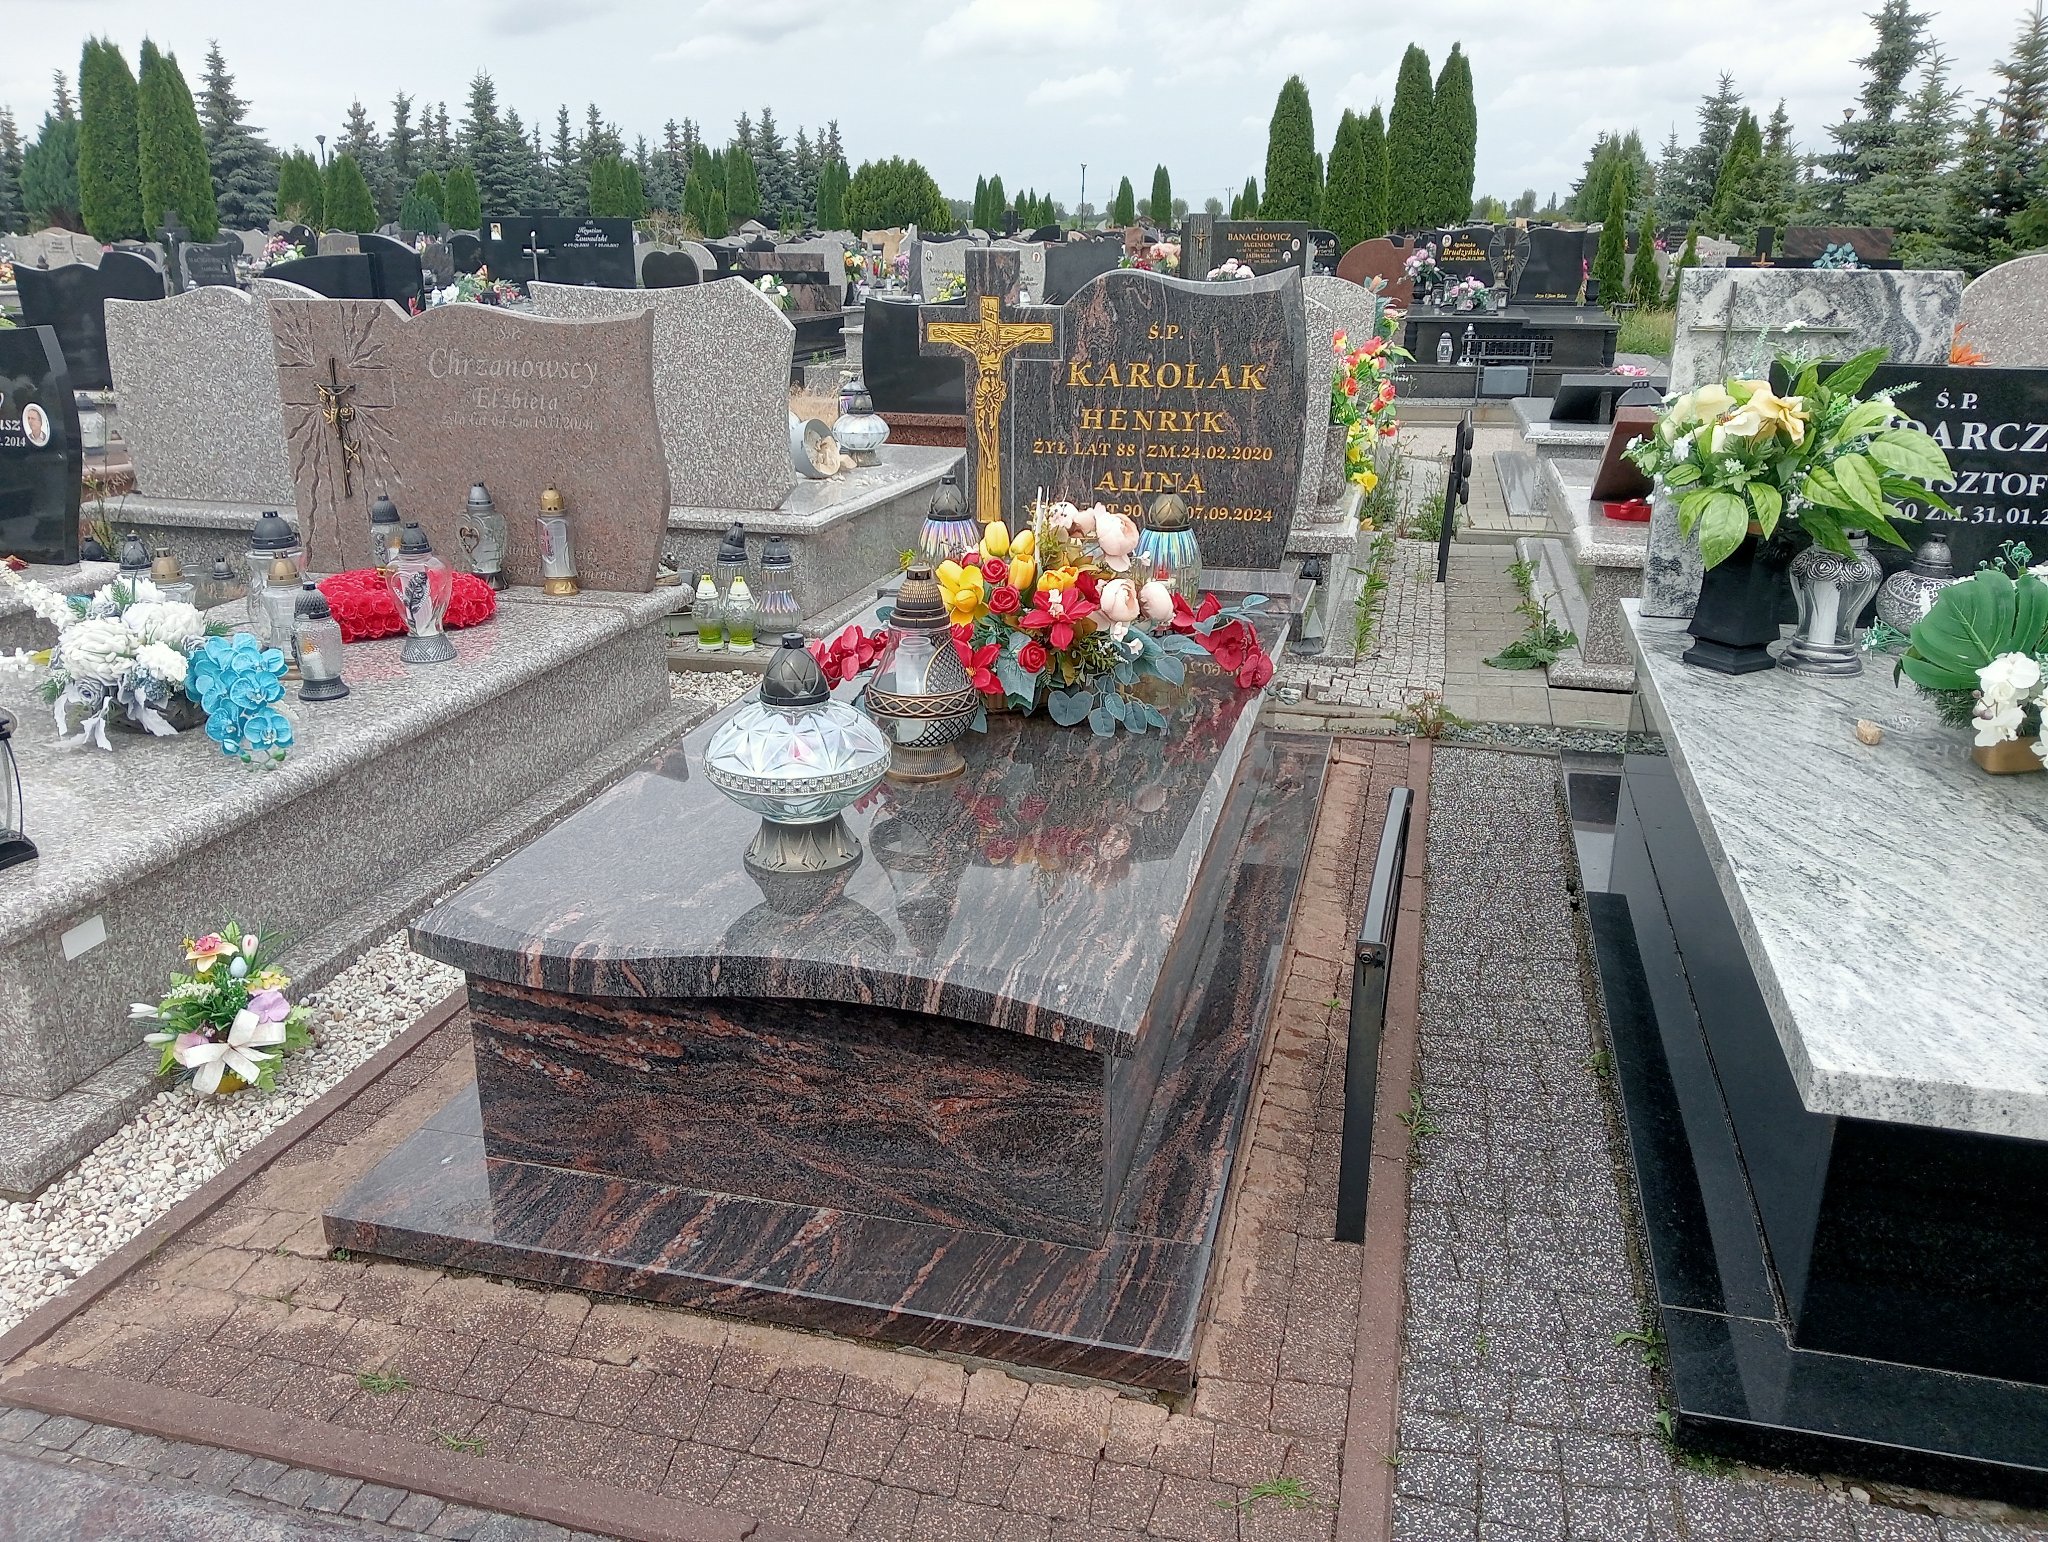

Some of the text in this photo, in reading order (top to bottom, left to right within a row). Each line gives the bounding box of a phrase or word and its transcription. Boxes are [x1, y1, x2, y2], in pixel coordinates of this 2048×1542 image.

[1227, 233, 1292, 241] BANACHOWICZ
[1443, 247, 1486, 257] Brudzyńska
[1148, 321, 1184, 340] Ś.P.
[428, 347, 599, 389] Chrzanowscy
[1066, 361, 1268, 391] KAROLAK
[1080, 408, 1226, 434] HENRYK
[1032, 437, 1274, 461] ŻYŁ LAT 88 ZM.24.02.2020
[1094, 470, 1206, 494] ALINA
[1123, 503, 1143, 518] 90
[1186, 506, 1274, 523] 07.09.2024
